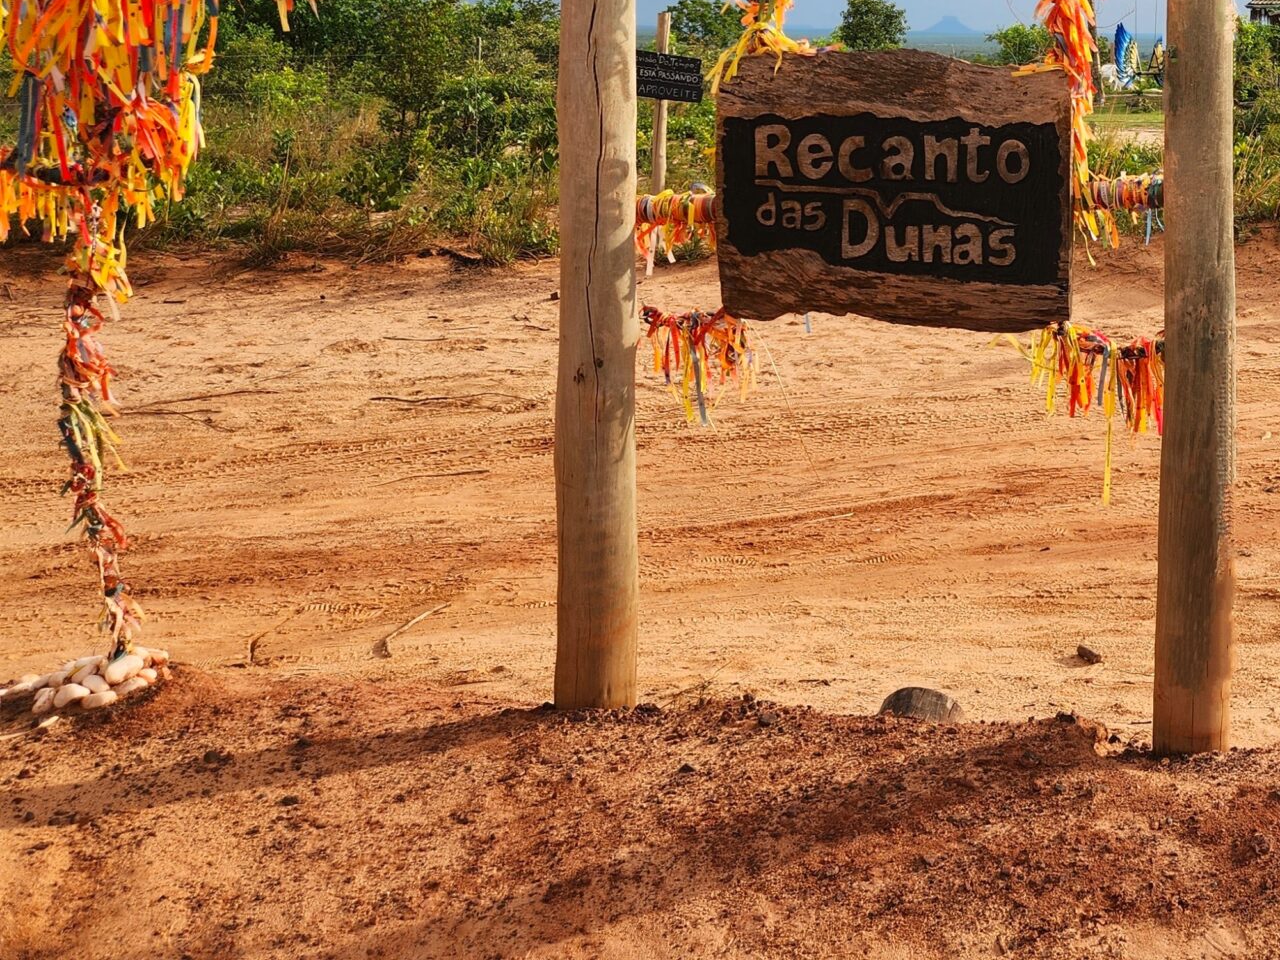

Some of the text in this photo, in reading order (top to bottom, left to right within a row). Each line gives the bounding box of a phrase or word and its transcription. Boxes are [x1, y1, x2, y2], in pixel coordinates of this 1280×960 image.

[638, 84, 698, 99] APROVEITE
[658, 71, 698, 83] PASSANDO
[754, 124, 1030, 184] Recanto
[755, 192, 1017, 266] das Dunas
